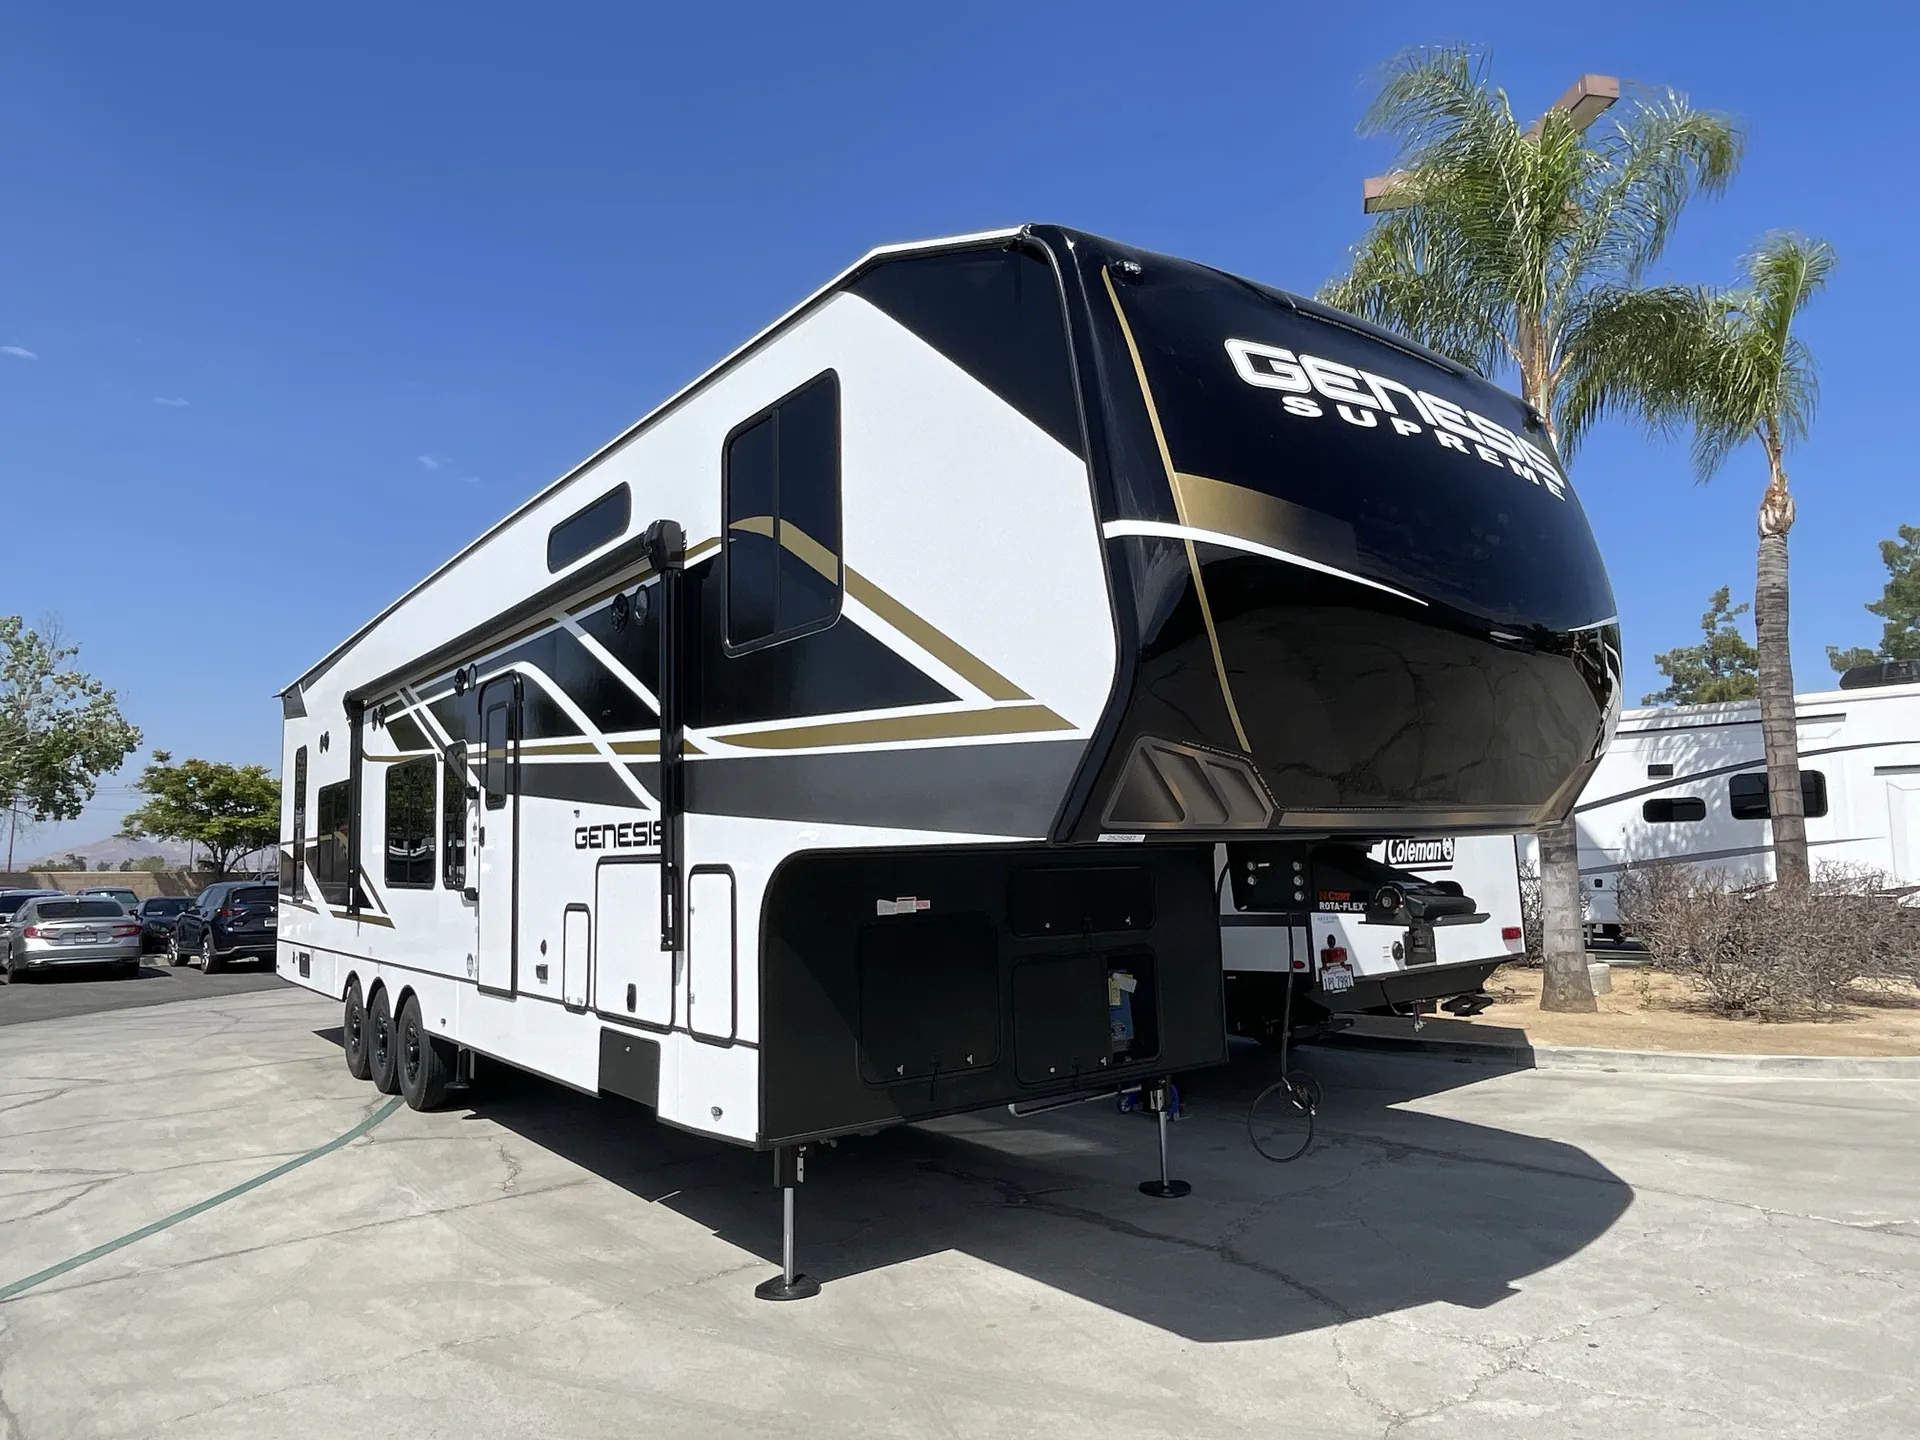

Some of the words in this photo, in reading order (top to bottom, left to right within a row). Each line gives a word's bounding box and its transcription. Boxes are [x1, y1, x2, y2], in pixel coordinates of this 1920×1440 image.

[1224, 338, 1565, 489] GENESIS
[1282, 395, 1565, 501] SUPREME
[1388, 838, 1442, 864] Coleman
